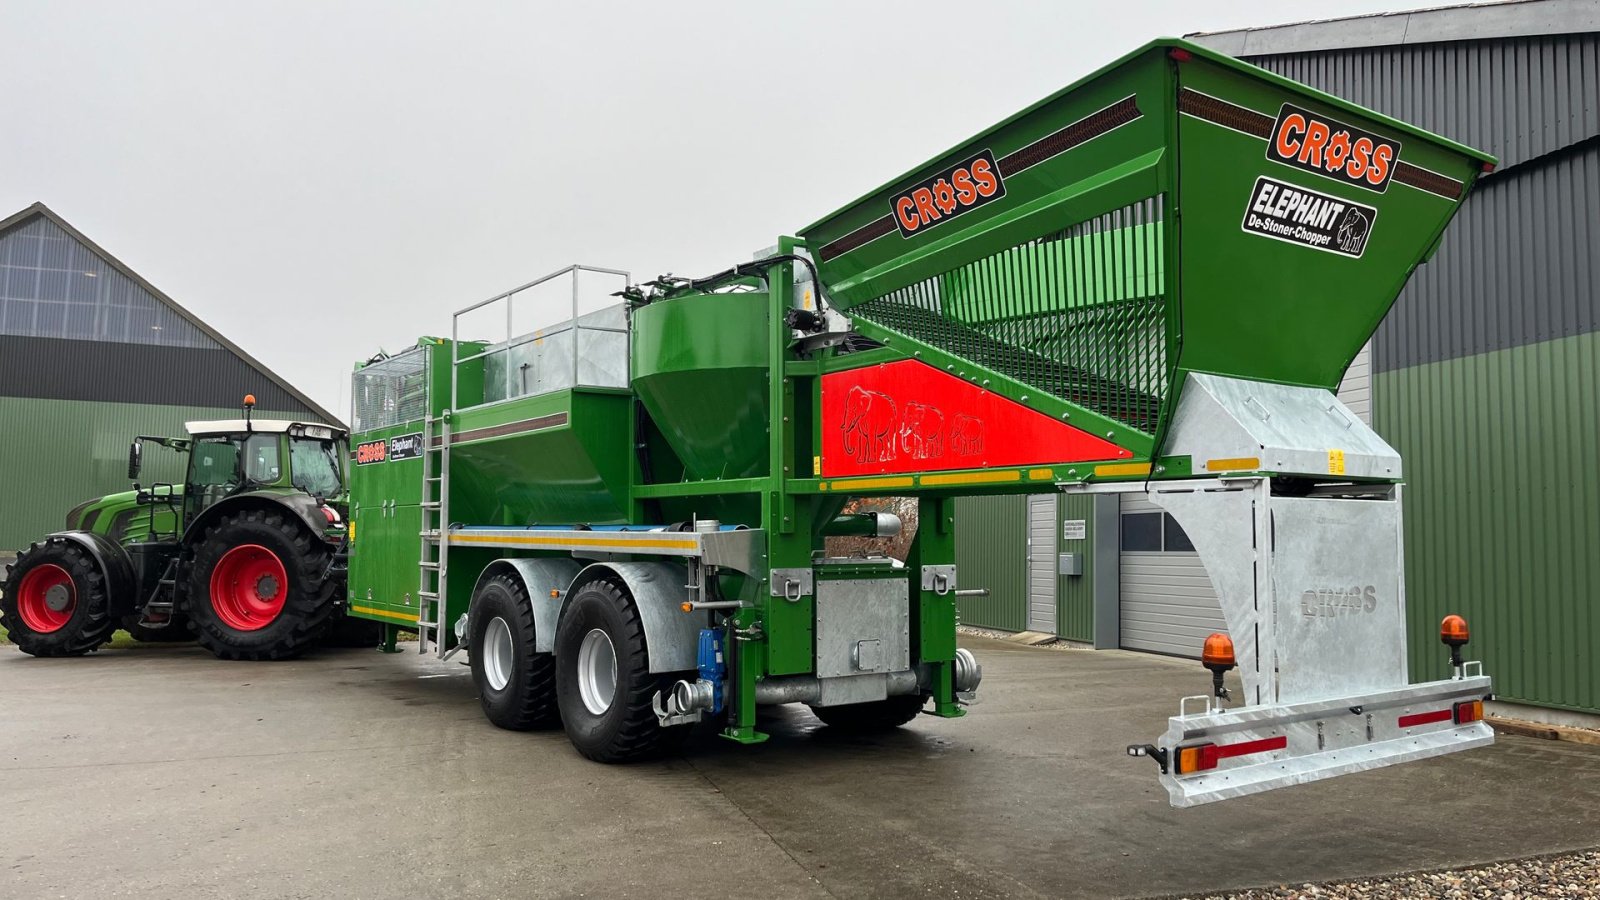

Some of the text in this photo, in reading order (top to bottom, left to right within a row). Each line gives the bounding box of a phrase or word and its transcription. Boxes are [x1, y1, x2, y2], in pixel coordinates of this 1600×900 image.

[1276, 113, 1392, 184] CROSS
[897, 159, 997, 231] CROSS
[1253, 183, 1345, 230] ELEPHANT
[1248, 214, 1331, 245] De-Stoner-Chopper
[358, 442, 385, 463] CROSS
[392, 437, 413, 453] Elephant
